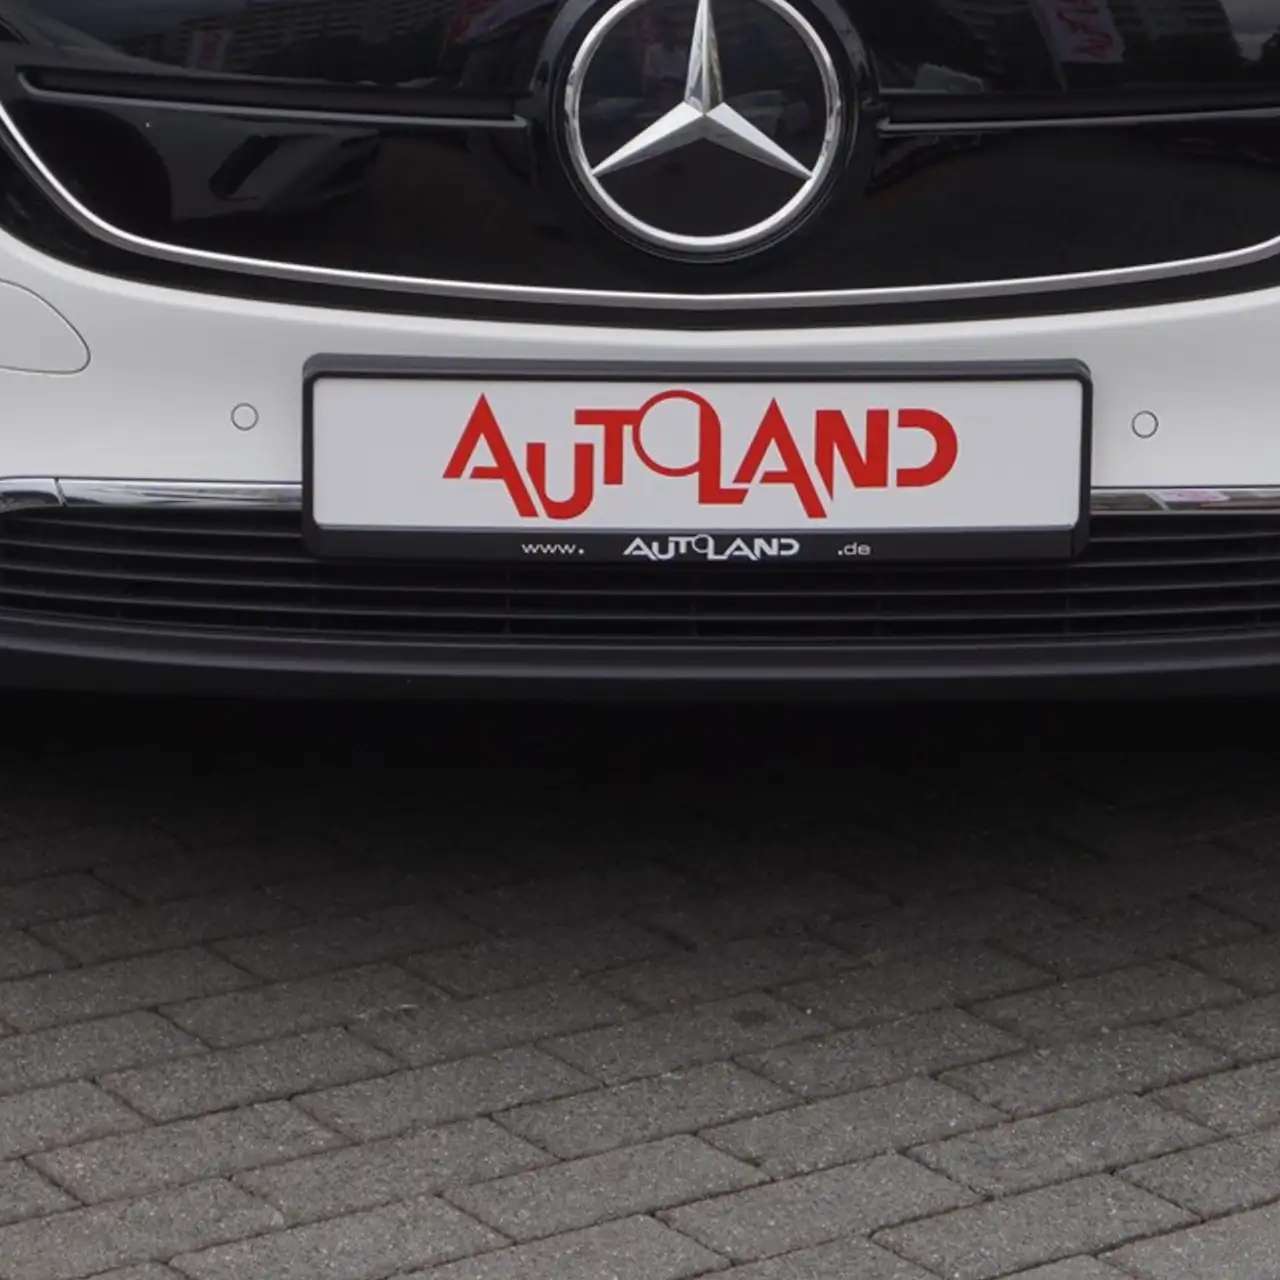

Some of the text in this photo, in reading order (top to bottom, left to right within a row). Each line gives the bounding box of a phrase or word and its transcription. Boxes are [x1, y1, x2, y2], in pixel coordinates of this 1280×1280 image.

[442, 390, 959, 520] AUTOLAND
[521, 534, 871, 561] www. AUTOLAND .de
